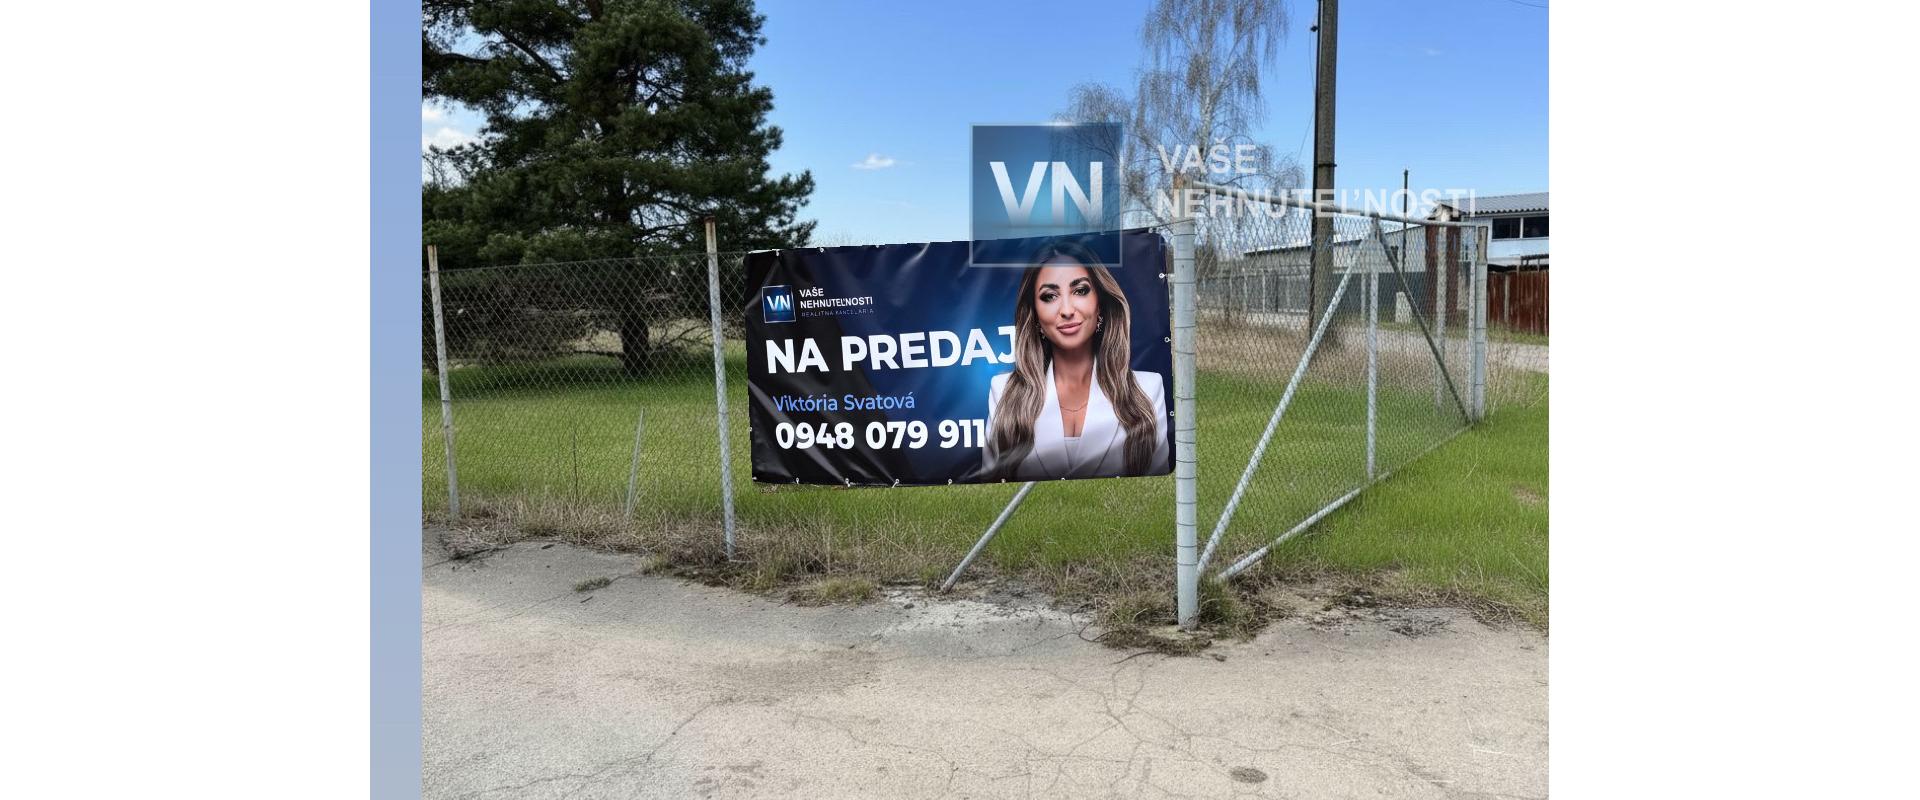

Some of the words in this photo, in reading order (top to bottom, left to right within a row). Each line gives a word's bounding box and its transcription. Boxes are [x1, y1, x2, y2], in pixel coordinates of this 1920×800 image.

[799, 286, 824, 298] VAŠE
[766, 294, 791, 312] VN
[800, 296, 873, 309] NEHNUTEĽNOSTI
[765, 337, 829, 374] NA
[841, 325, 1016, 371] PREDAJ
[773, 394, 838, 412] Viktória
[844, 392, 915, 411] Svatová
[775, 422, 855, 450] 0948
[865, 420, 928, 450] 079
[938, 419, 985, 449] 911
